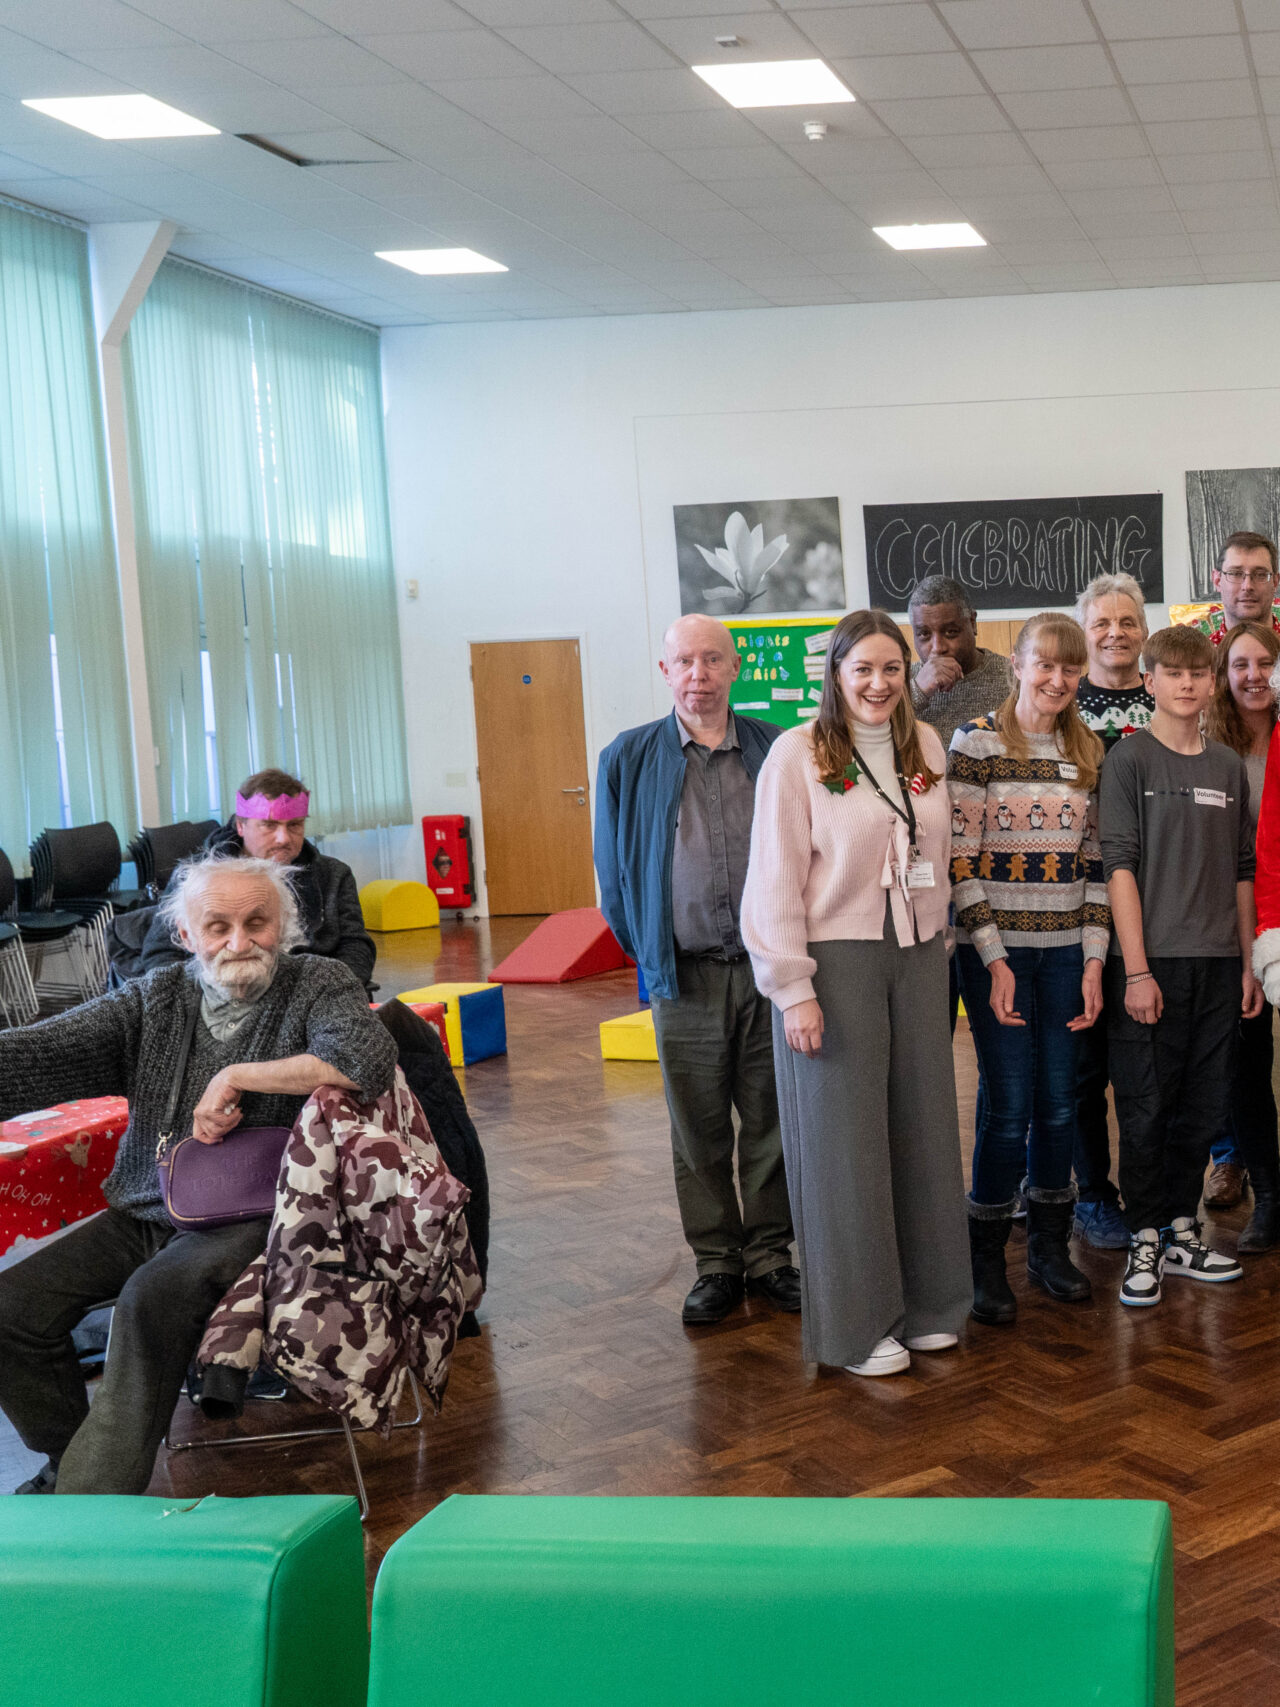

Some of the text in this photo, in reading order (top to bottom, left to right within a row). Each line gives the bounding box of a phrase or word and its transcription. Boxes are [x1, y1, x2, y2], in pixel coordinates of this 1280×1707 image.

[875, 515, 1152, 600] CELEBRATING
[747, 651, 765, 668] of
[1196, 790, 1224, 801] Volunteer
